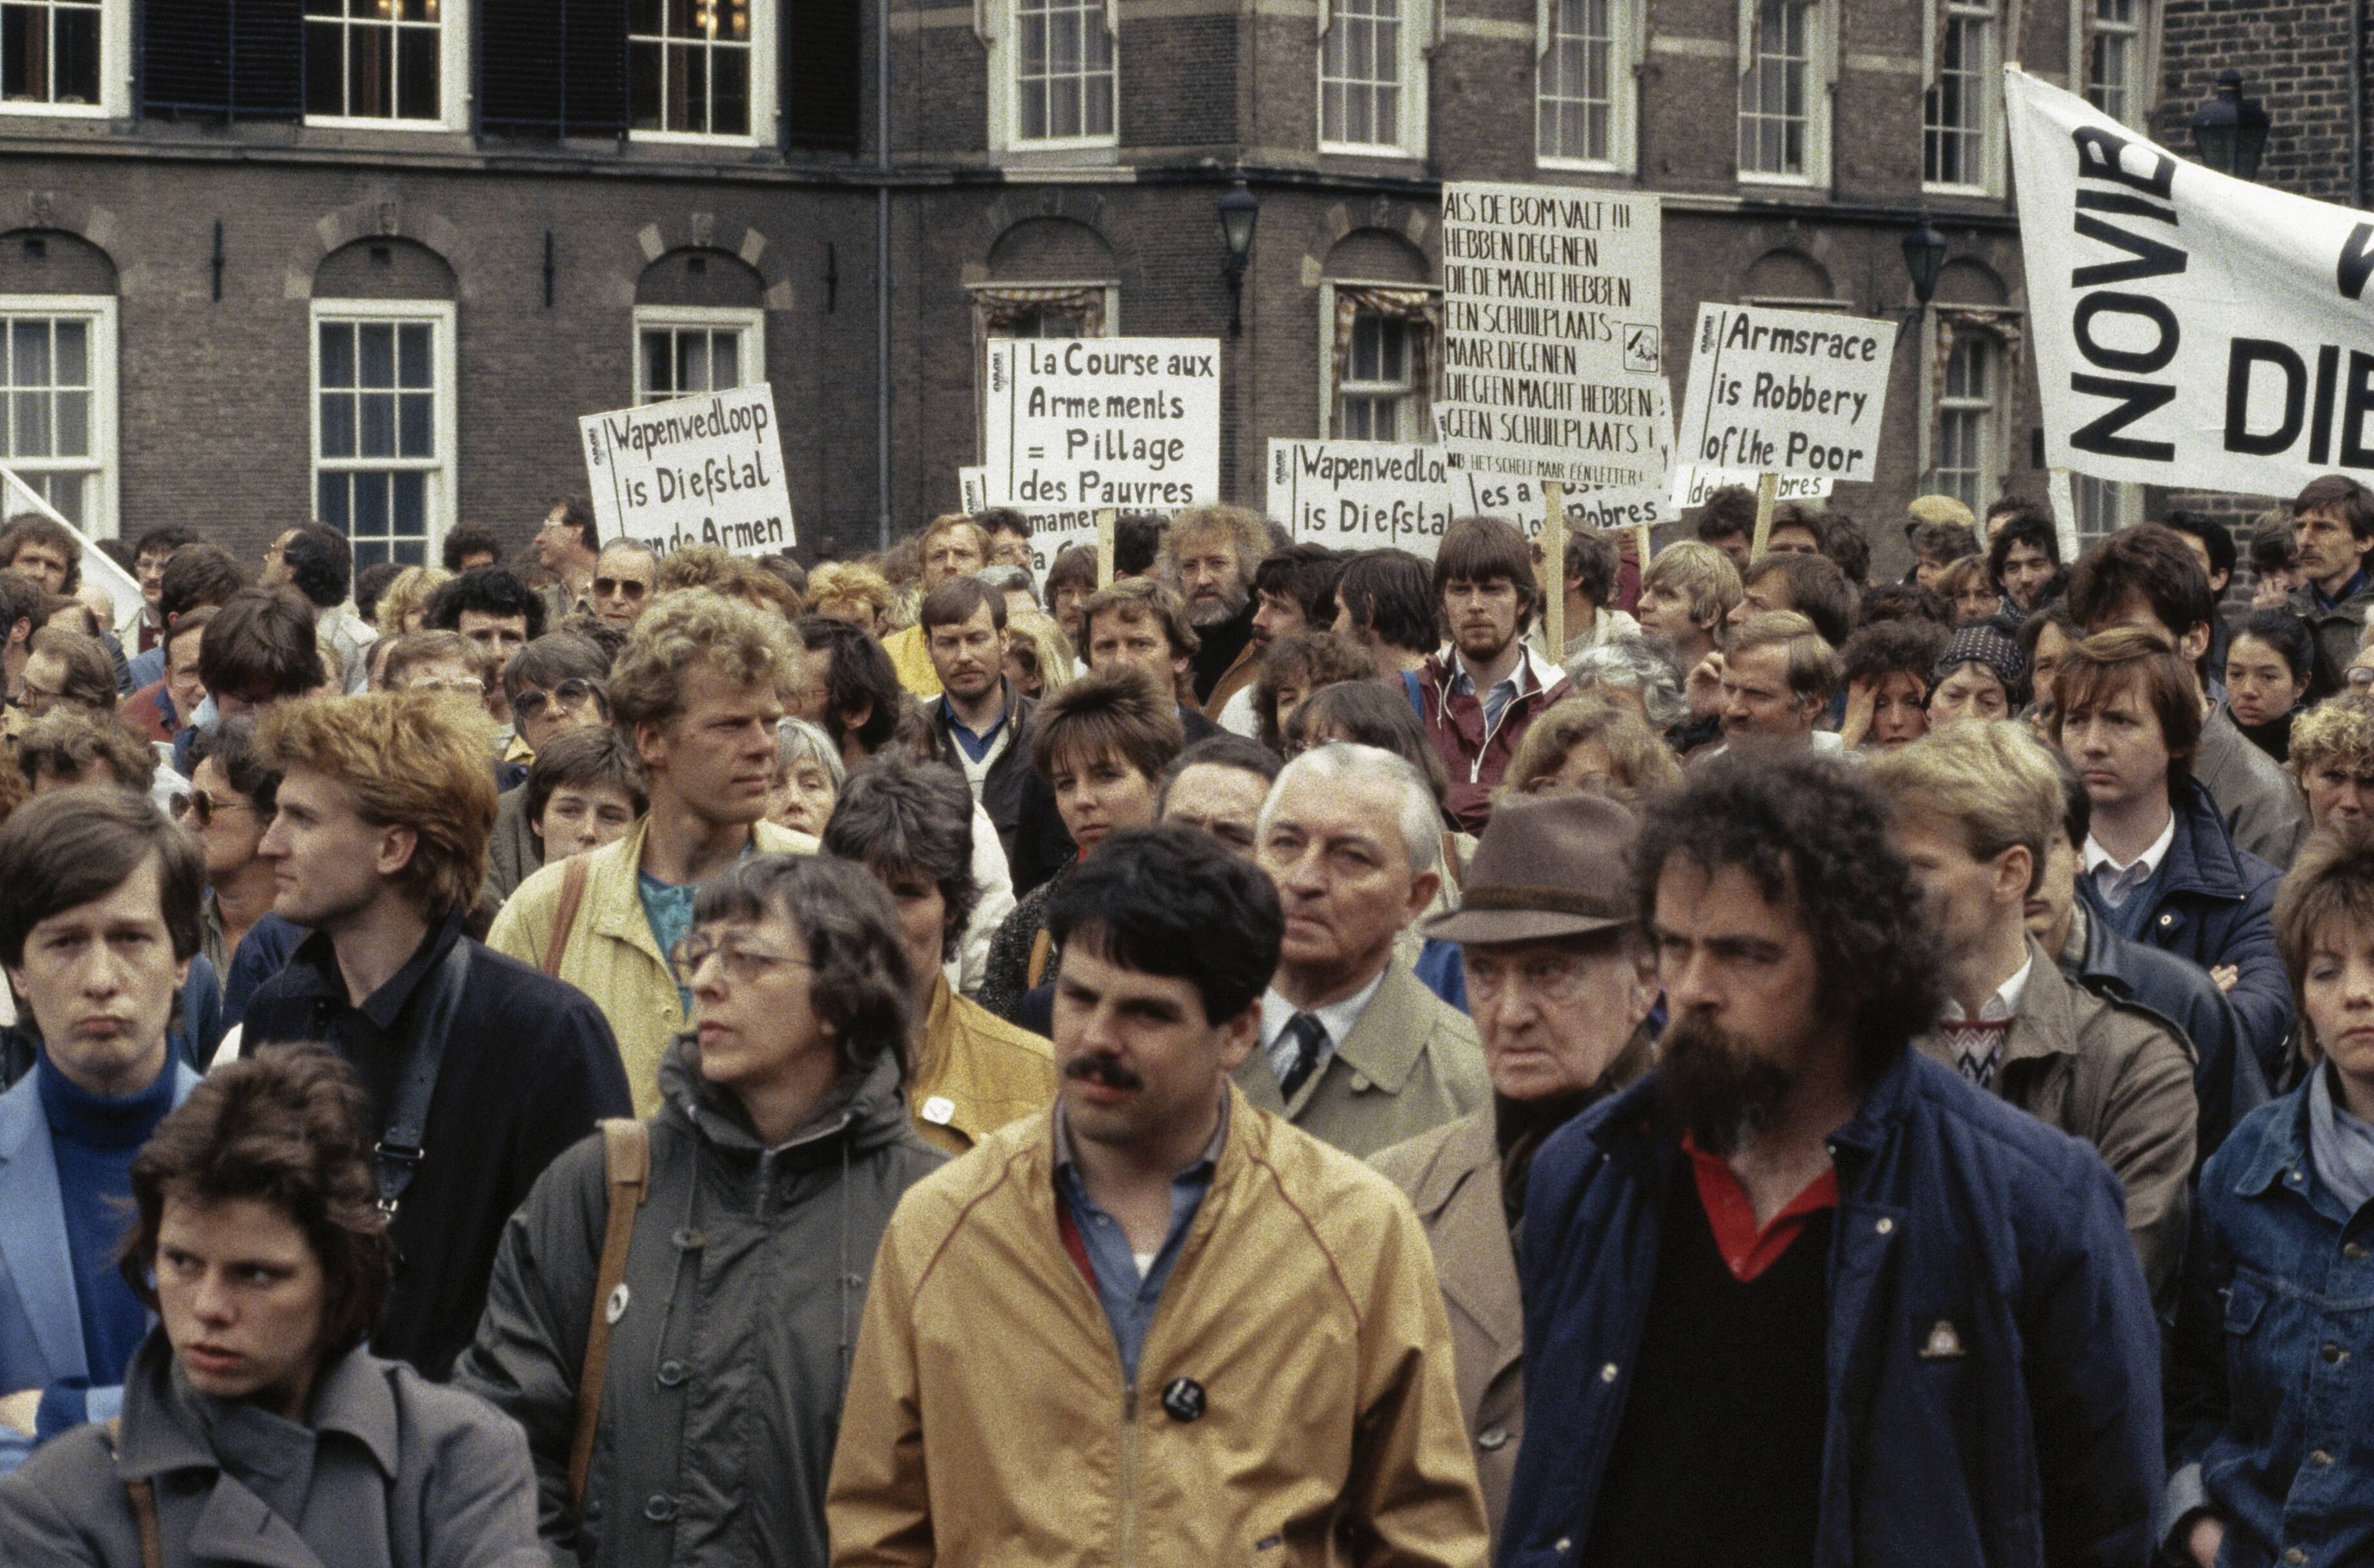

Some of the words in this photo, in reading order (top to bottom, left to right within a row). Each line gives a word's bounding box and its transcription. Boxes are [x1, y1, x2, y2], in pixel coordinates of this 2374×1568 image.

[1444, 192, 1476, 221] ALS
[1481, 195, 1506, 224] DE
[1510, 196, 1557, 228] BOM
[1560, 200, 1602, 231] VALT
[1444, 228, 1513, 262] HEBBEN
[1518, 233, 1598, 267] DEGENEN
[1498, 268, 1558, 301] MACHT
[1562, 272, 1631, 308] HEBBEN
[2070, 126, 2189, 462] NOVIB
[1445, 300, 1479, 332] EEN
[1446, 336, 1494, 370] MAAR
[1499, 340, 1577, 376] DEGENEN
[1725, 313, 1877, 362] Armsrace
[1064, 342, 1159, 376] Course
[1167, 353, 1215, 377] aux
[1519, 378, 1575, 412] MACHT
[1581, 383, 1653, 418] HEBBEN
[1718, 373, 1742, 406] is
[1753, 372, 1867, 426] Robbery
[609, 397, 768, 462] Wapenwedloop
[1066, 428, 1184, 471] Pillage
[1447, 408, 1493, 441] GEEN
[1501, 413, 1639, 453] SCHUILPLAATS
[1706, 426, 1737, 468] of
[1786, 431, 1864, 473] Poor
[625, 477, 647, 509] is
[655, 450, 771, 506] Diefstal
[1020, 469, 1068, 501] des
[1079, 470, 1193, 504] Pauvres
[1471, 454, 1491, 471] HET
[1537, 460, 1565, 479] MAAR
[702, 516, 784, 548] Armen
[1304, 501, 1327, 531] is
